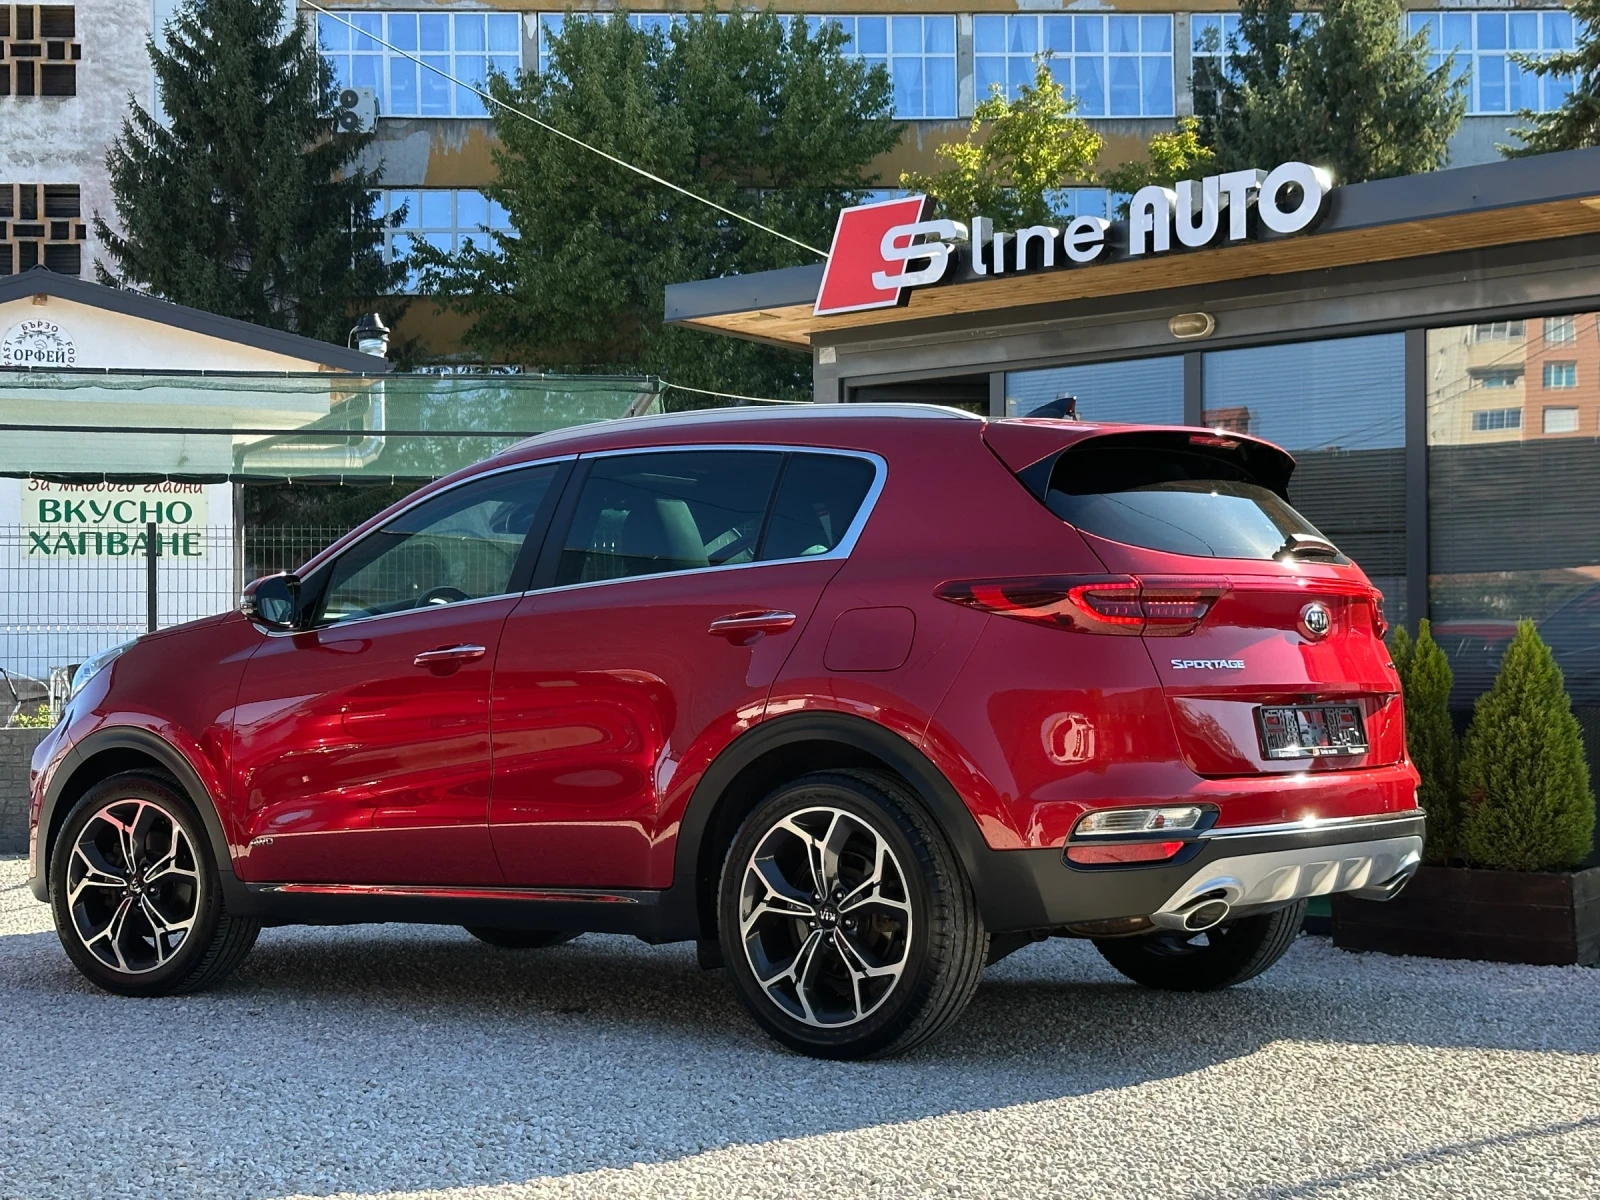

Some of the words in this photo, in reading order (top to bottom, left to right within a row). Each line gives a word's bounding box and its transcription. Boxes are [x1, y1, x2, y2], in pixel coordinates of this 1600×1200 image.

[872, 219, 957, 290] S
[972, 215, 1106, 275] line
[1129, 161, 1323, 255] AUTO
[21, 320, 59, 333] БЪРЗО
[13, 348, 66, 363] ОРФЕЙ
[39, 499, 193, 524] ВКУСНО
[29, 530, 203, 556] ХАПВАНЕ
[1170, 659, 1246, 670] SPORTAGE
